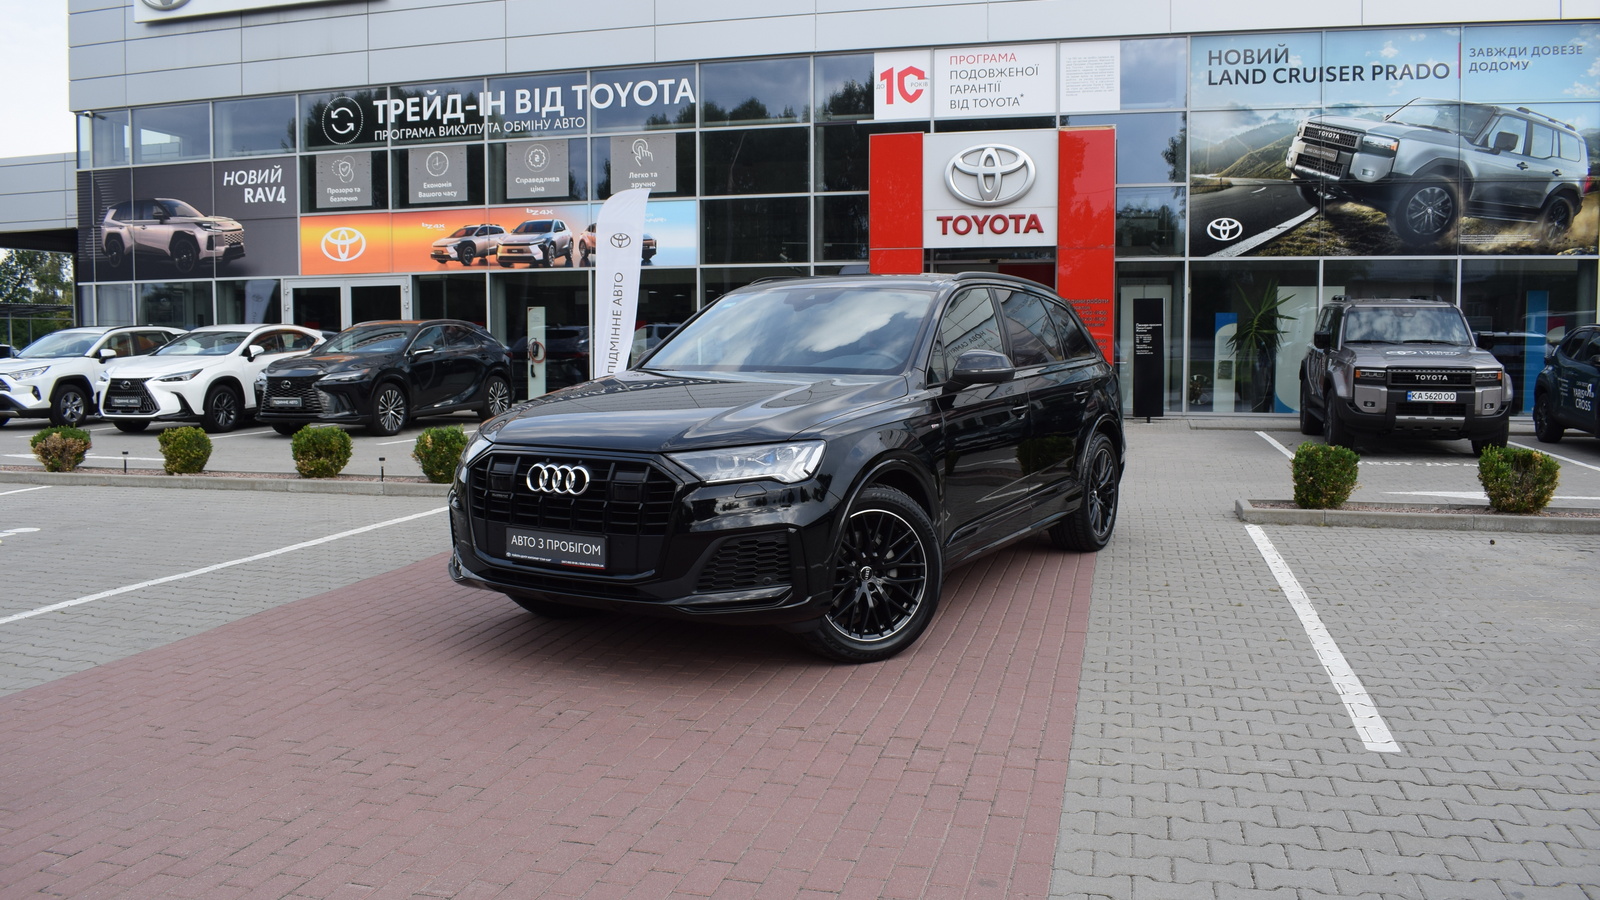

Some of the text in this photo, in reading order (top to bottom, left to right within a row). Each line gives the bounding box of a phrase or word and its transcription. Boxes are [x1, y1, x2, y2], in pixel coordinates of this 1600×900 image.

[949, 53, 1017, 65] ПРОГРАМА
[1208, 43, 1289, 66] НОВИЙ
[1469, 45, 1583, 58] ЗАВЖДИ ДОВЕЗЕ
[949, 63, 1040, 81] ПОДОВЖЕНОЇ
[1208, 62, 1450, 86] LAND CRUISER PRADO
[1468, 60, 1530, 73] ДОДОМУ
[949, 80, 1003, 95] ГАРАНТІЇ
[372, 78, 696, 125] ТРЕЙД-ІН ВІД TOYOTA
[949, 98, 970, 110] ВІД
[374, 116, 586, 141] ПРОГРАМА ВИКУПУ ТА ОБМІНУ АВТО
[1318, 130, 1340, 140] TOYOTA
[223, 164, 283, 187] НОВИЙ
[515, 176, 560, 185] Справедлива
[628, 171, 650, 179] Легко
[244, 186, 287, 204] RAV4
[530, 185, 545, 194] ціна
[936, 213, 1045, 236] TOYOTA
[607, 272, 624, 373] ПІДМІННЕ АВТО
[1411, 392, 1423, 400] KA
[1424, 392, 1443, 401] 5620
[1575, 398, 1591, 411] CROSS
[511, 534, 536, 548] АВТО
[546, 539, 601, 556] ПРОБІГОМ
